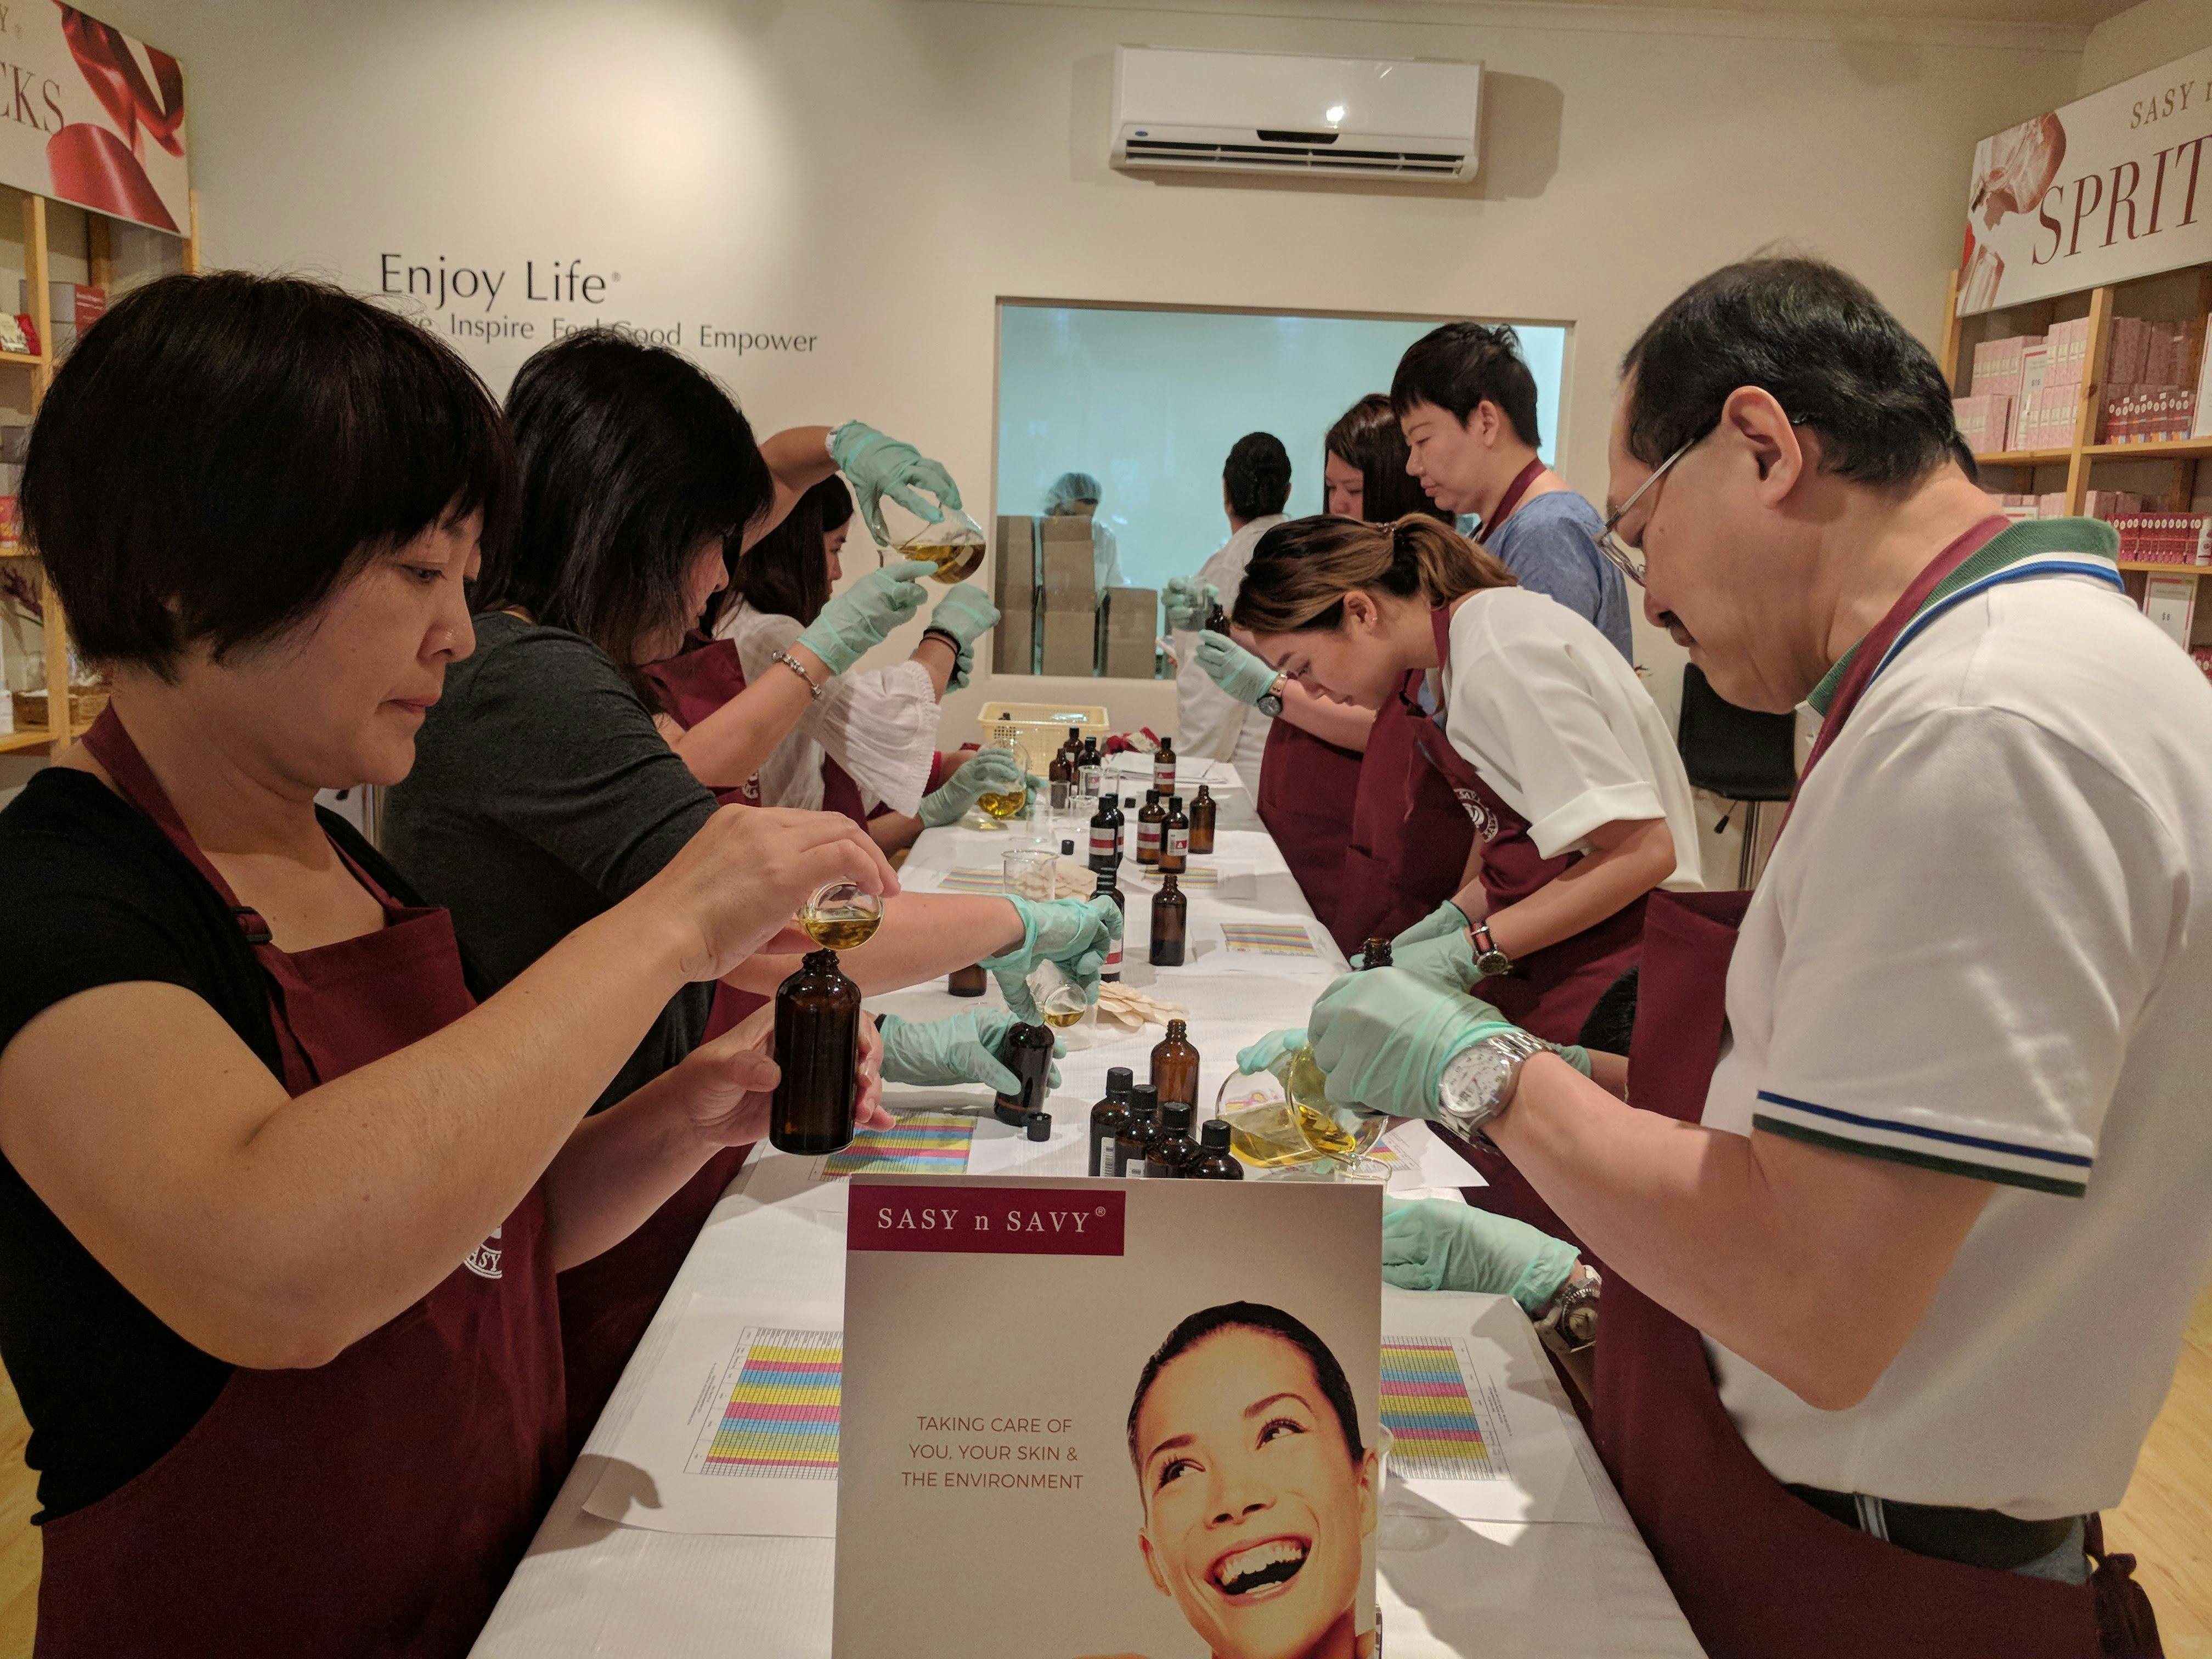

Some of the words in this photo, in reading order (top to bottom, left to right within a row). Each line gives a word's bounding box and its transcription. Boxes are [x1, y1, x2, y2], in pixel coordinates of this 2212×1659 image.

[2131, 81, 2194, 129] SASY
[382, 253, 505, 312] Enjoy
[451, 313, 534, 345] Inspire
[700, 325, 818, 357] Empower
[878, 1208, 959, 1230] SASY
[975, 1215, 990, 1231] n
[917, 1416, 985, 1432] TAKING
[991, 1418, 1041, 1433] CARE
[1047, 1419, 1073, 1433] OF
[909, 1444, 952, 1460] YOU,
[958, 1445, 1011, 1460] YOUR
[1018, 1446, 1059, 1460] SKIN
[1066, 1447, 1078, 1462] &
[901, 1472, 937, 1487] THE
[945, 1472, 1084, 1489] ENVIRONMENT
